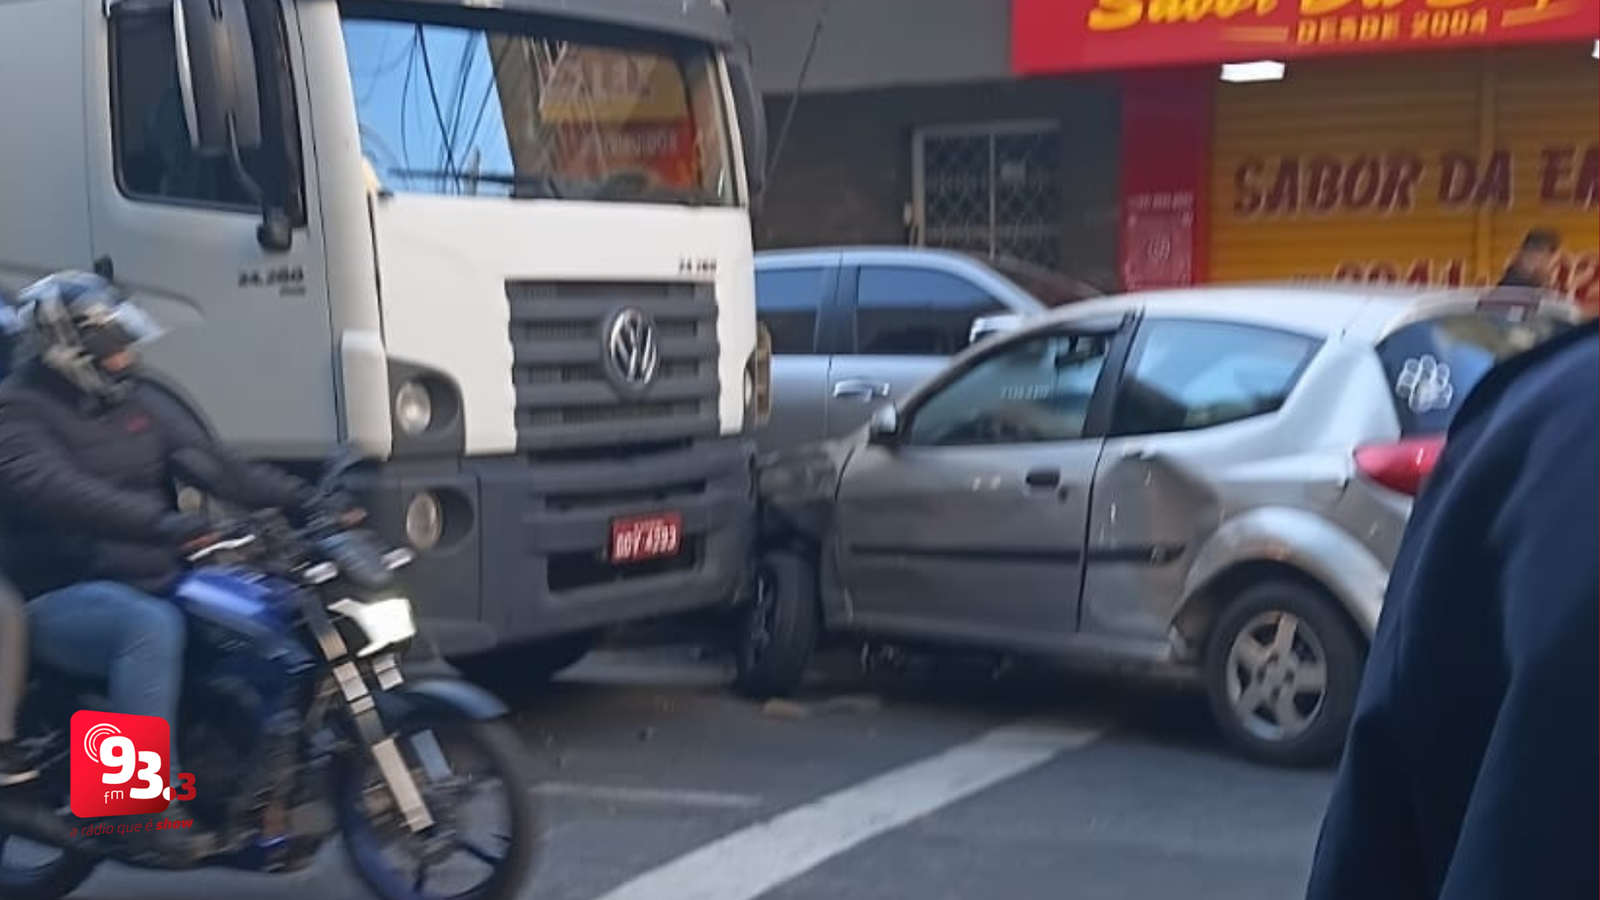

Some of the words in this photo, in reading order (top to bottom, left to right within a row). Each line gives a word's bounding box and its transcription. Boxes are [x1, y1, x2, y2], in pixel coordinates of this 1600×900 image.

[1297, 13, 1400, 44] DESDE
[1411, 9, 1488, 40] 2004
[1233, 152, 1426, 222] SABOR
[1437, 148, 1514, 213] DA
